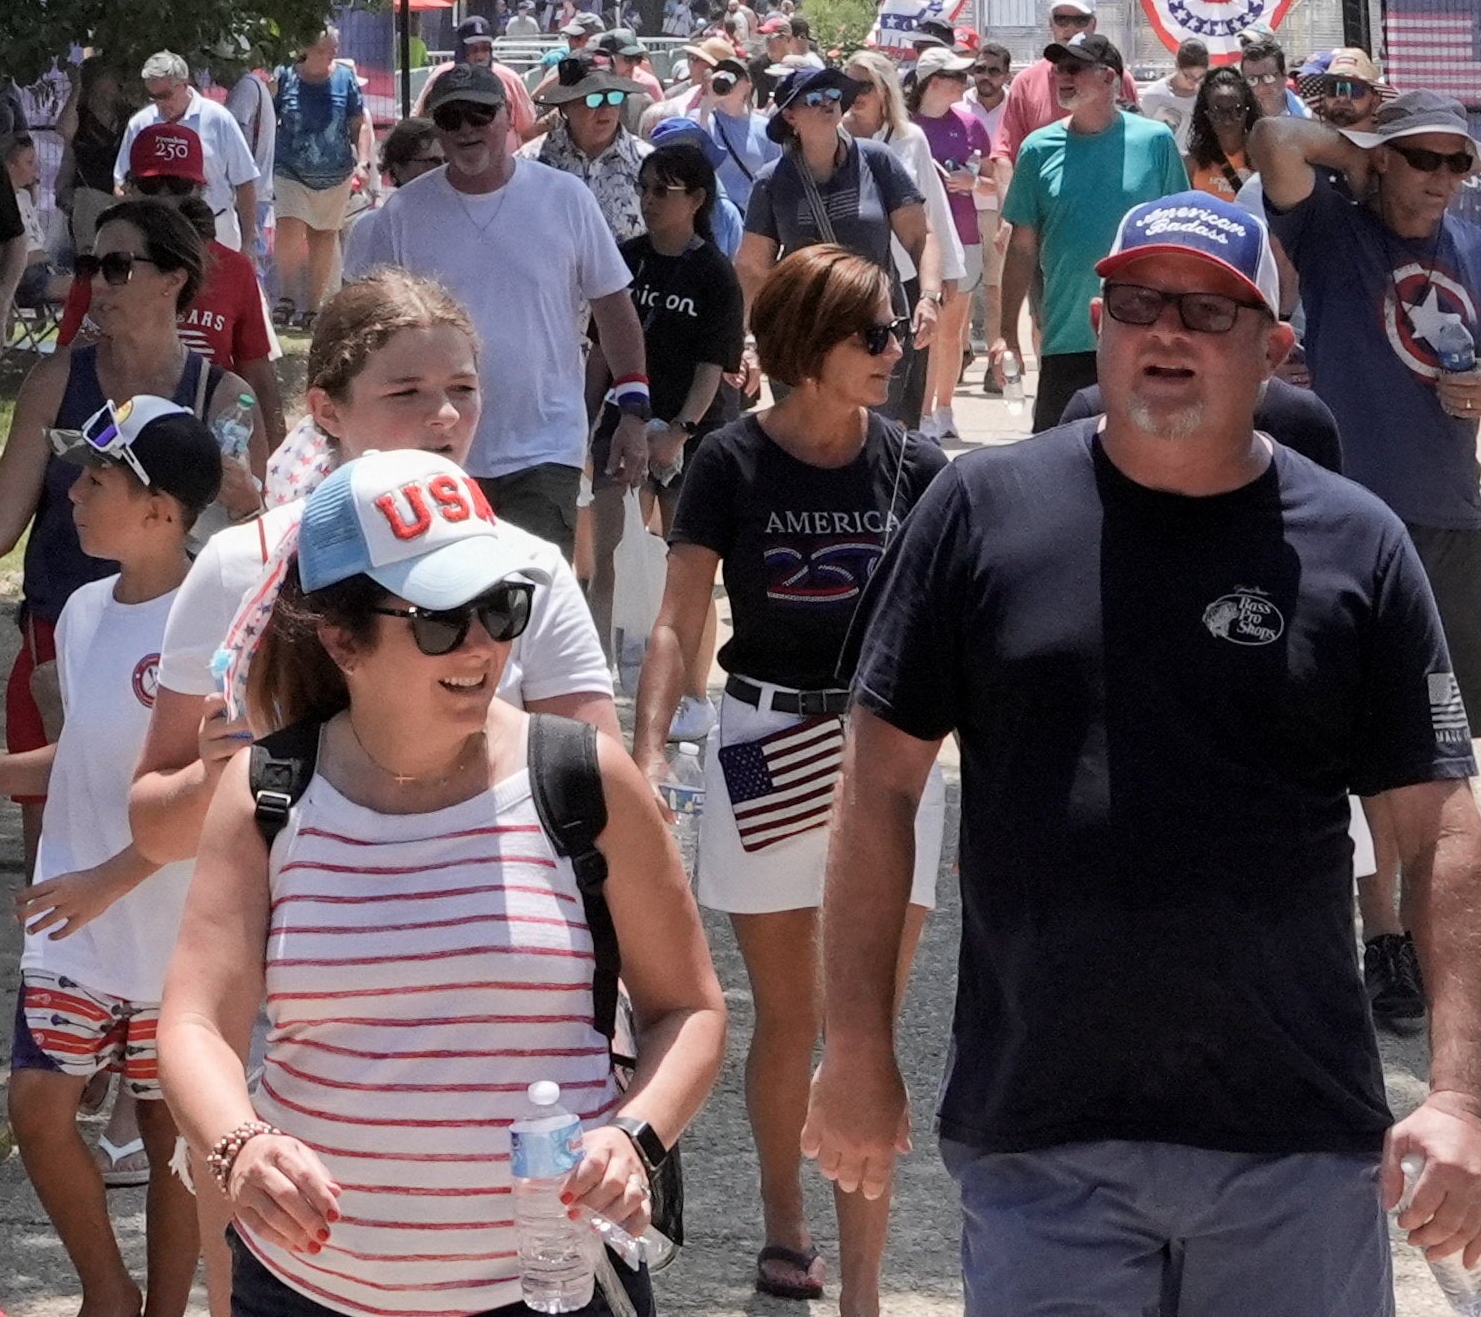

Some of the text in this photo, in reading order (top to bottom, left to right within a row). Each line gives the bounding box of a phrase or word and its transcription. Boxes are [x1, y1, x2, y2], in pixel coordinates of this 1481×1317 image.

[155, 143, 189, 161] 250
[1136, 207, 1247, 237] American
[1145, 218, 1229, 244] Badass
[764, 509, 902, 535] AMERICA
[1239, 596, 1271, 615] Bass
[1238, 608, 1263, 624] Pro
[1236, 620, 1277, 640] Shops
